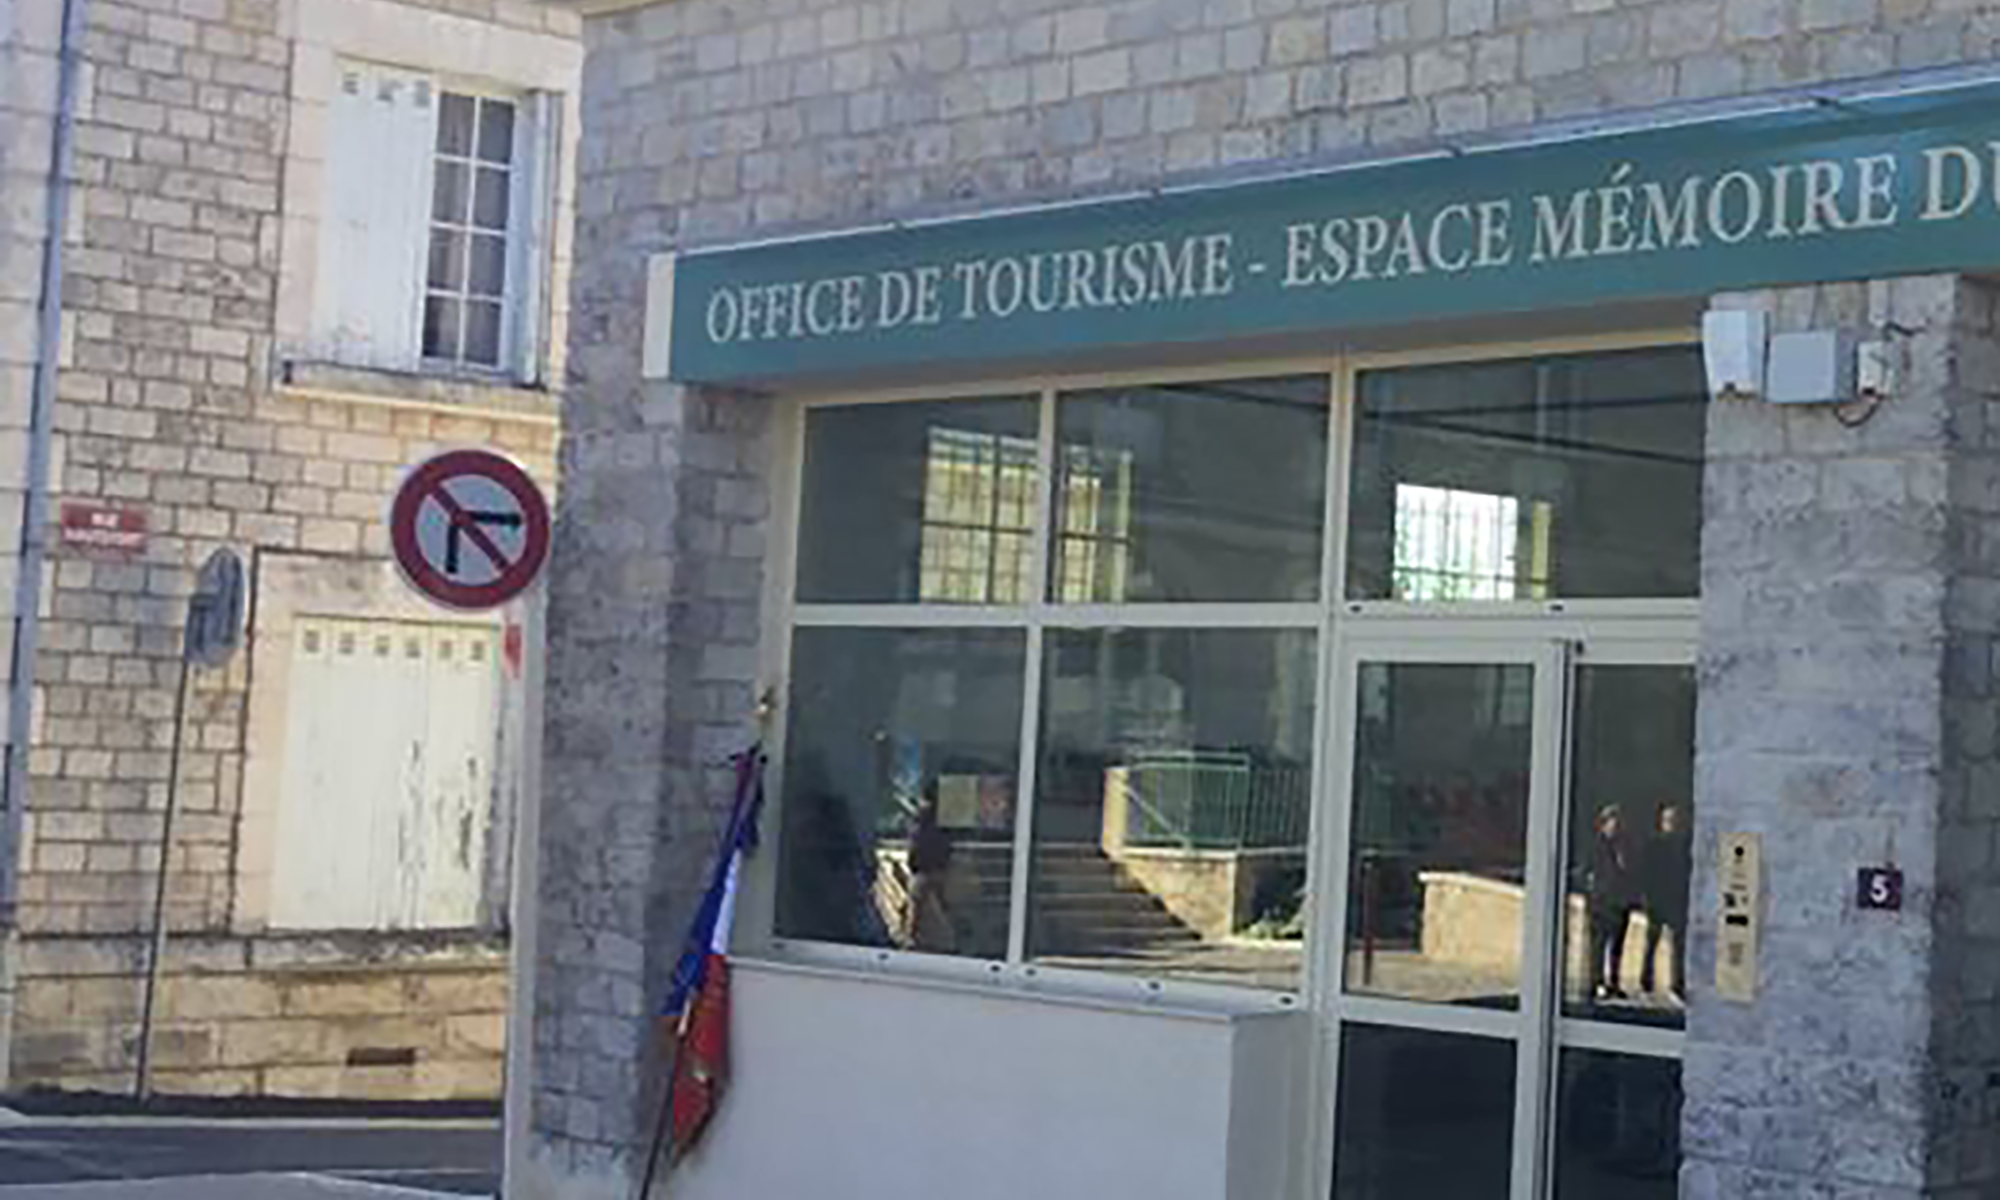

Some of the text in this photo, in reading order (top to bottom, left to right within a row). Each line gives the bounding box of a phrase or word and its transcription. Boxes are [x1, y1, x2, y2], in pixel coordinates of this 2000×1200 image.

[704, 275, 864, 343] OFFICE
[875, 266, 942, 328] DE
[952, 233, 1236, 319] TOURISME
[1281, 200, 1511, 288] ESPACE
[1530, 162, 1898, 262] MÉMOIRE
[1919, 140, 2000, 220] D
[1871, 874, 1888, 903] 5
